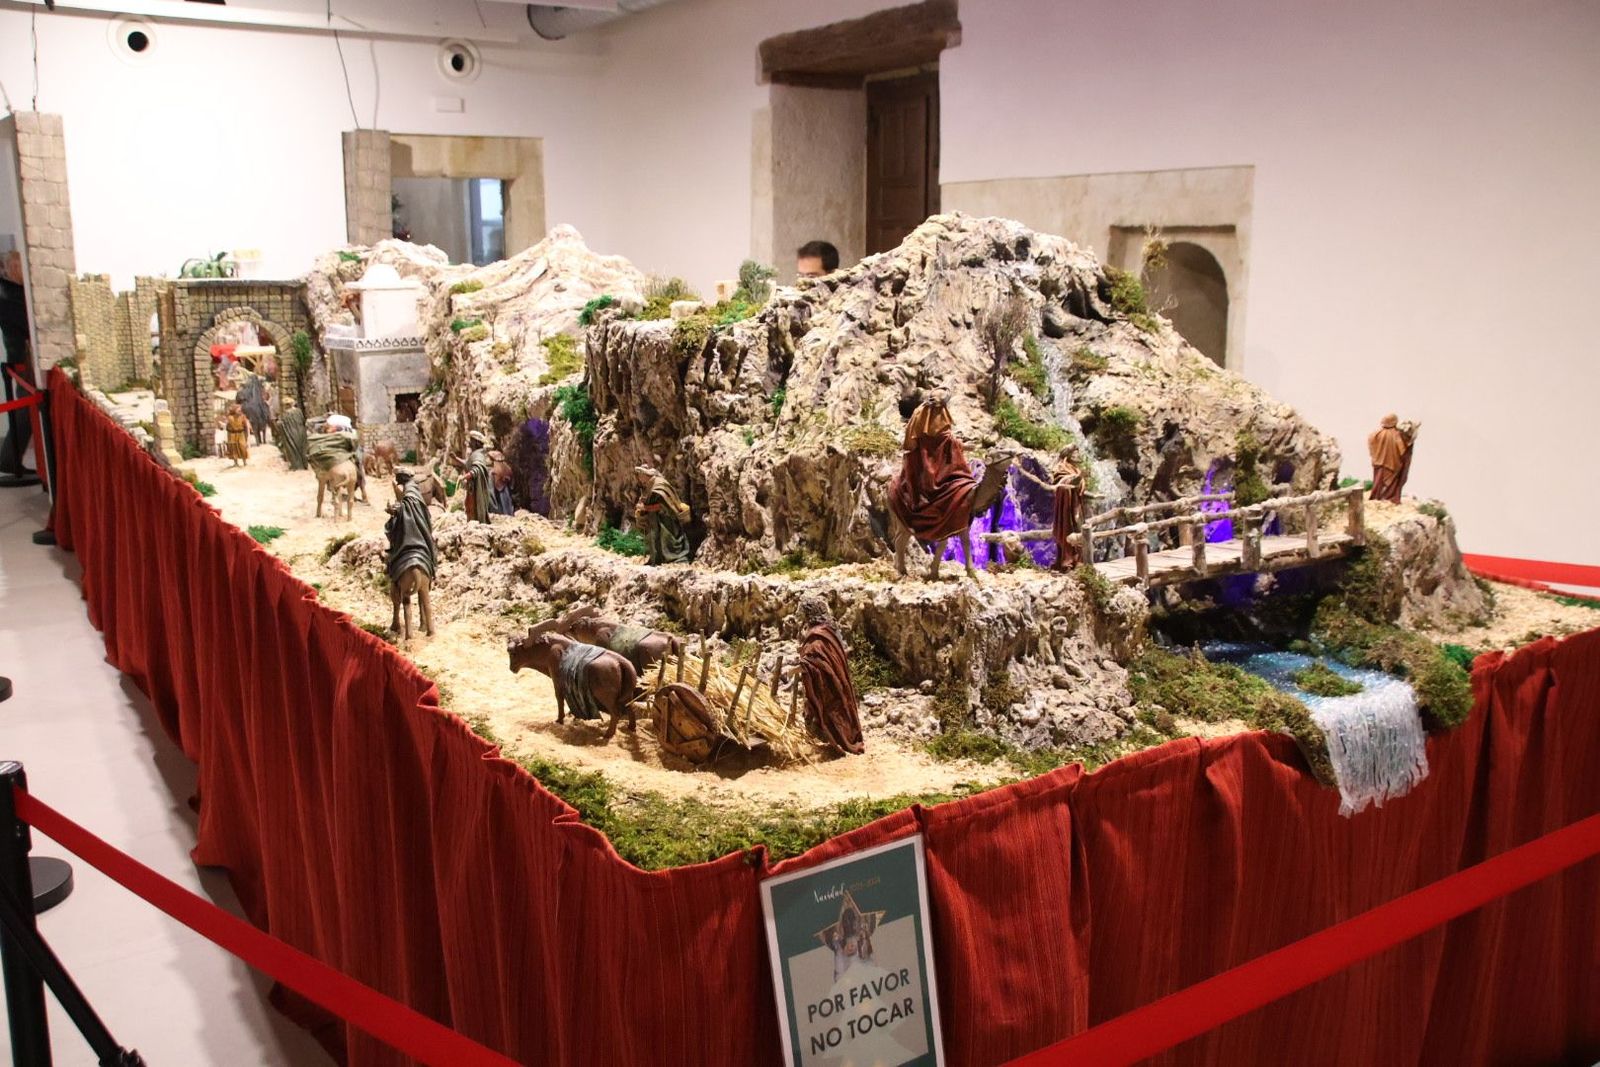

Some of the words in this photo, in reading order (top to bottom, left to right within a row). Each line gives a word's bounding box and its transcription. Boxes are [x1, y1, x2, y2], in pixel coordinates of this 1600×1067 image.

[808, 994, 845, 1023] POR
[849, 968, 910, 1007] FAVOR
[810, 1027, 842, 1056] NO
[847, 997, 914, 1039] TOCAR
